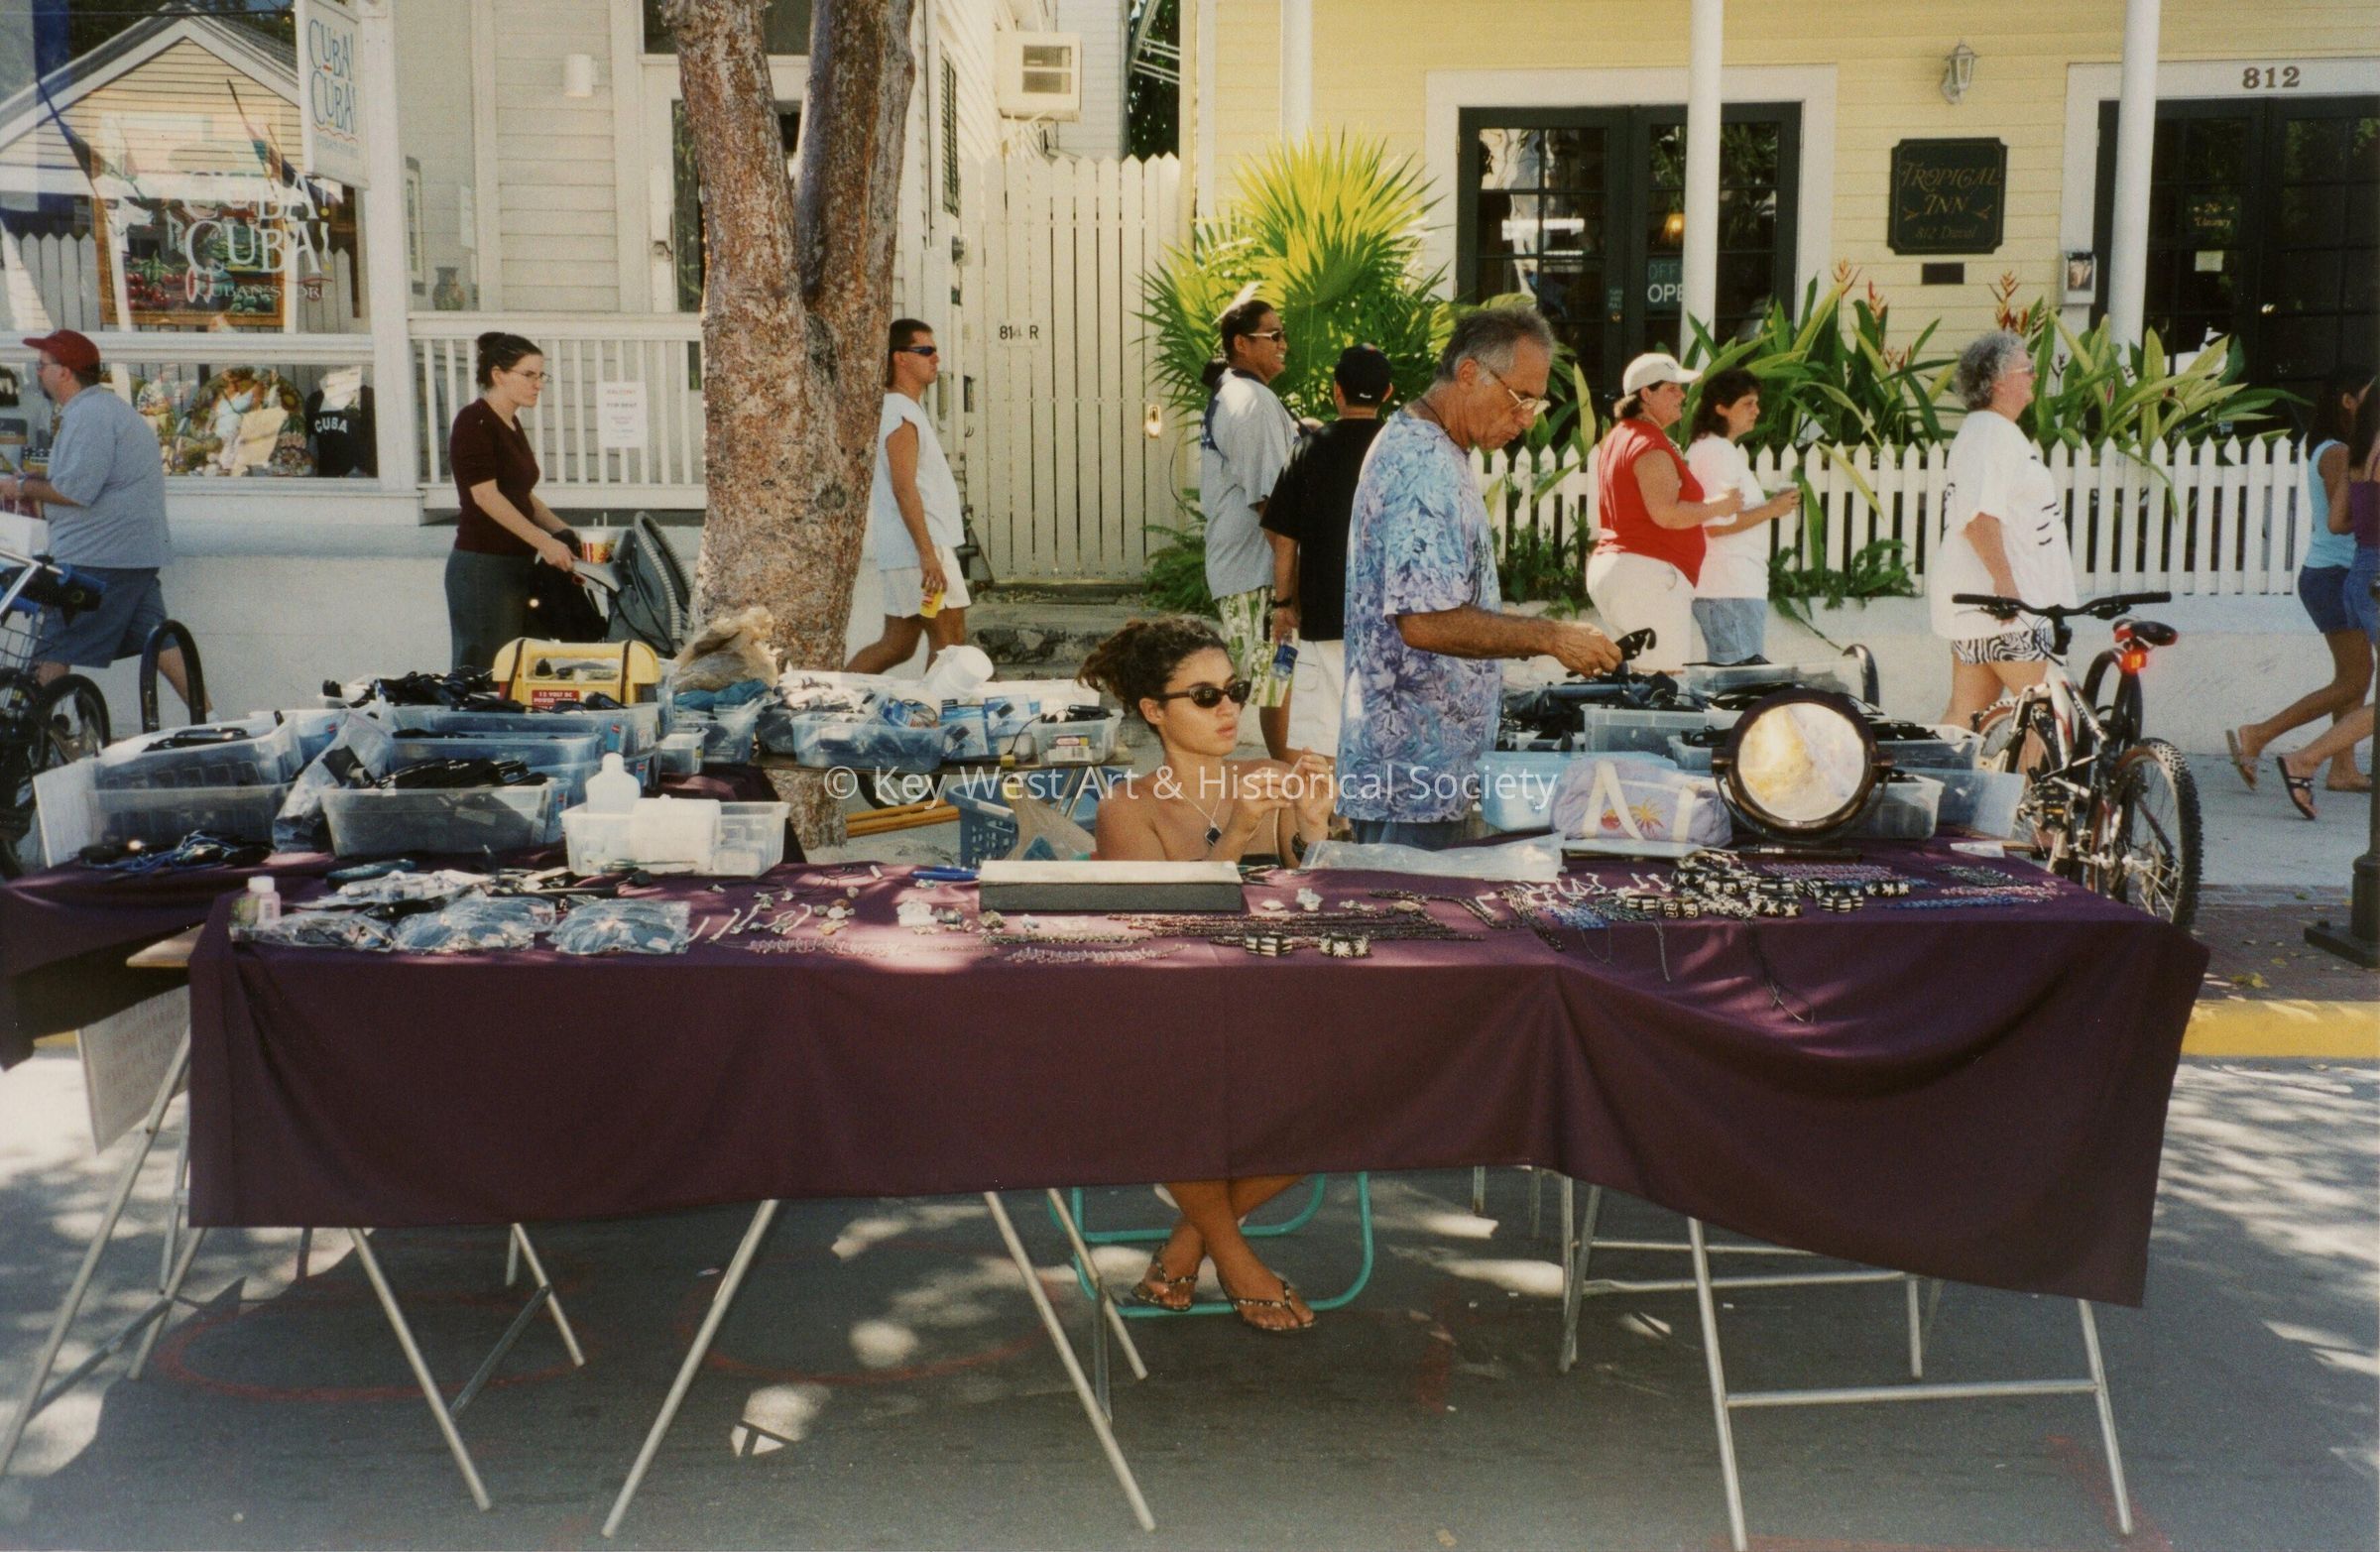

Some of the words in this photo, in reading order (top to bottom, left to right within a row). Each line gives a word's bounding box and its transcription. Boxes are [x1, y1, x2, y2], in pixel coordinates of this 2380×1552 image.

[2242, 65, 2300, 88] 812
[1902, 162, 2000, 191] TROPICAL
[1924, 193, 1970, 215] INN
[1647, 284, 1683, 302] OPE
[1029, 324, 1038, 339] R
[314, 417, 348, 434] CUBA
